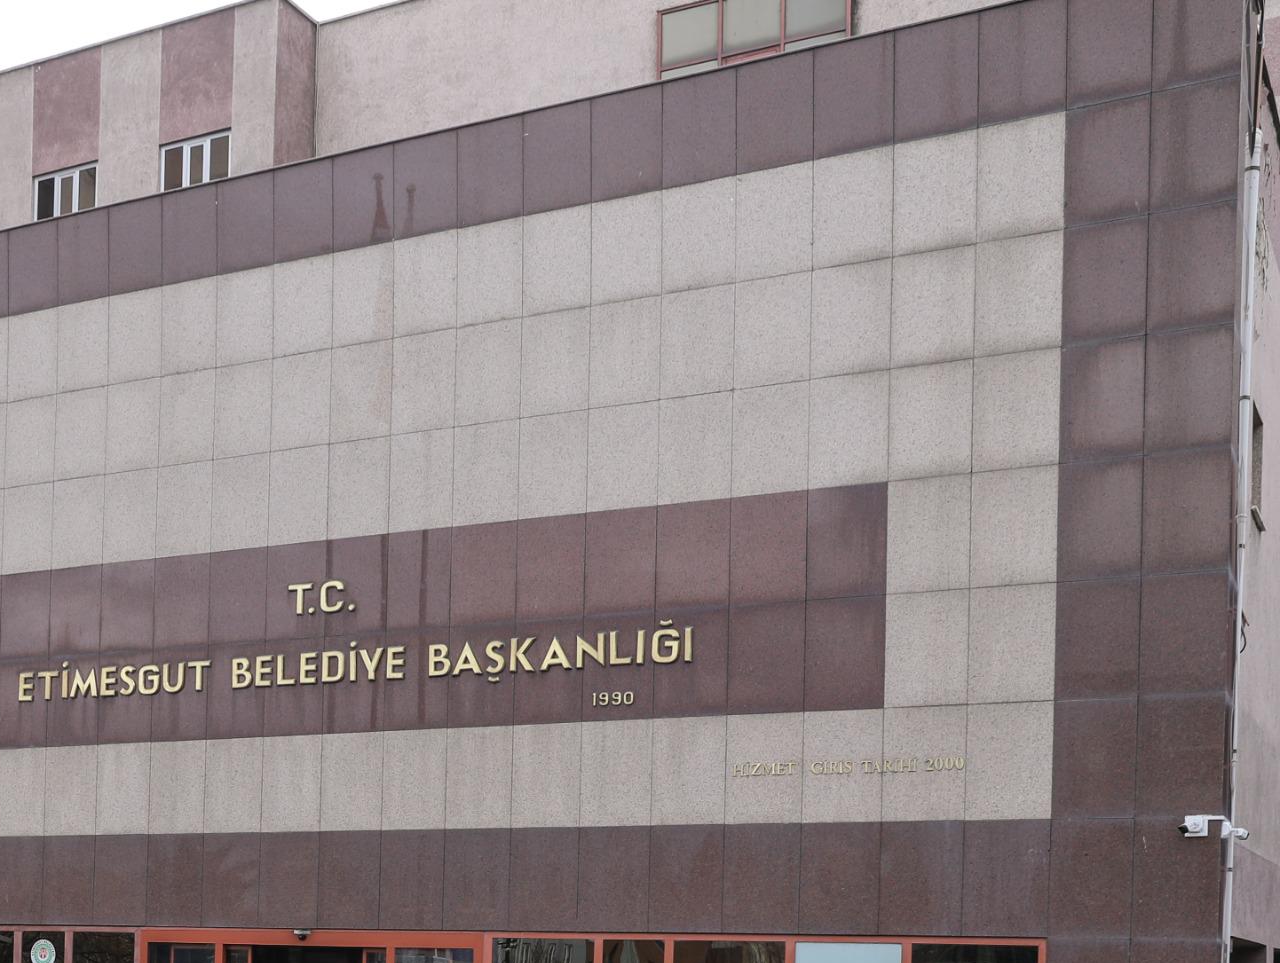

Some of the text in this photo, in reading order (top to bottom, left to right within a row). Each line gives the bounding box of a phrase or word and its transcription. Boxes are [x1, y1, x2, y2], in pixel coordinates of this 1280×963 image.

[288, 580, 356, 615] T.C.
[18, 618, 694, 701] ETİMESGUT BELEDİYE BAŞKANLIĞI
[592, 691, 634, 706] 1990
[925, 757, 965, 772] 2000
